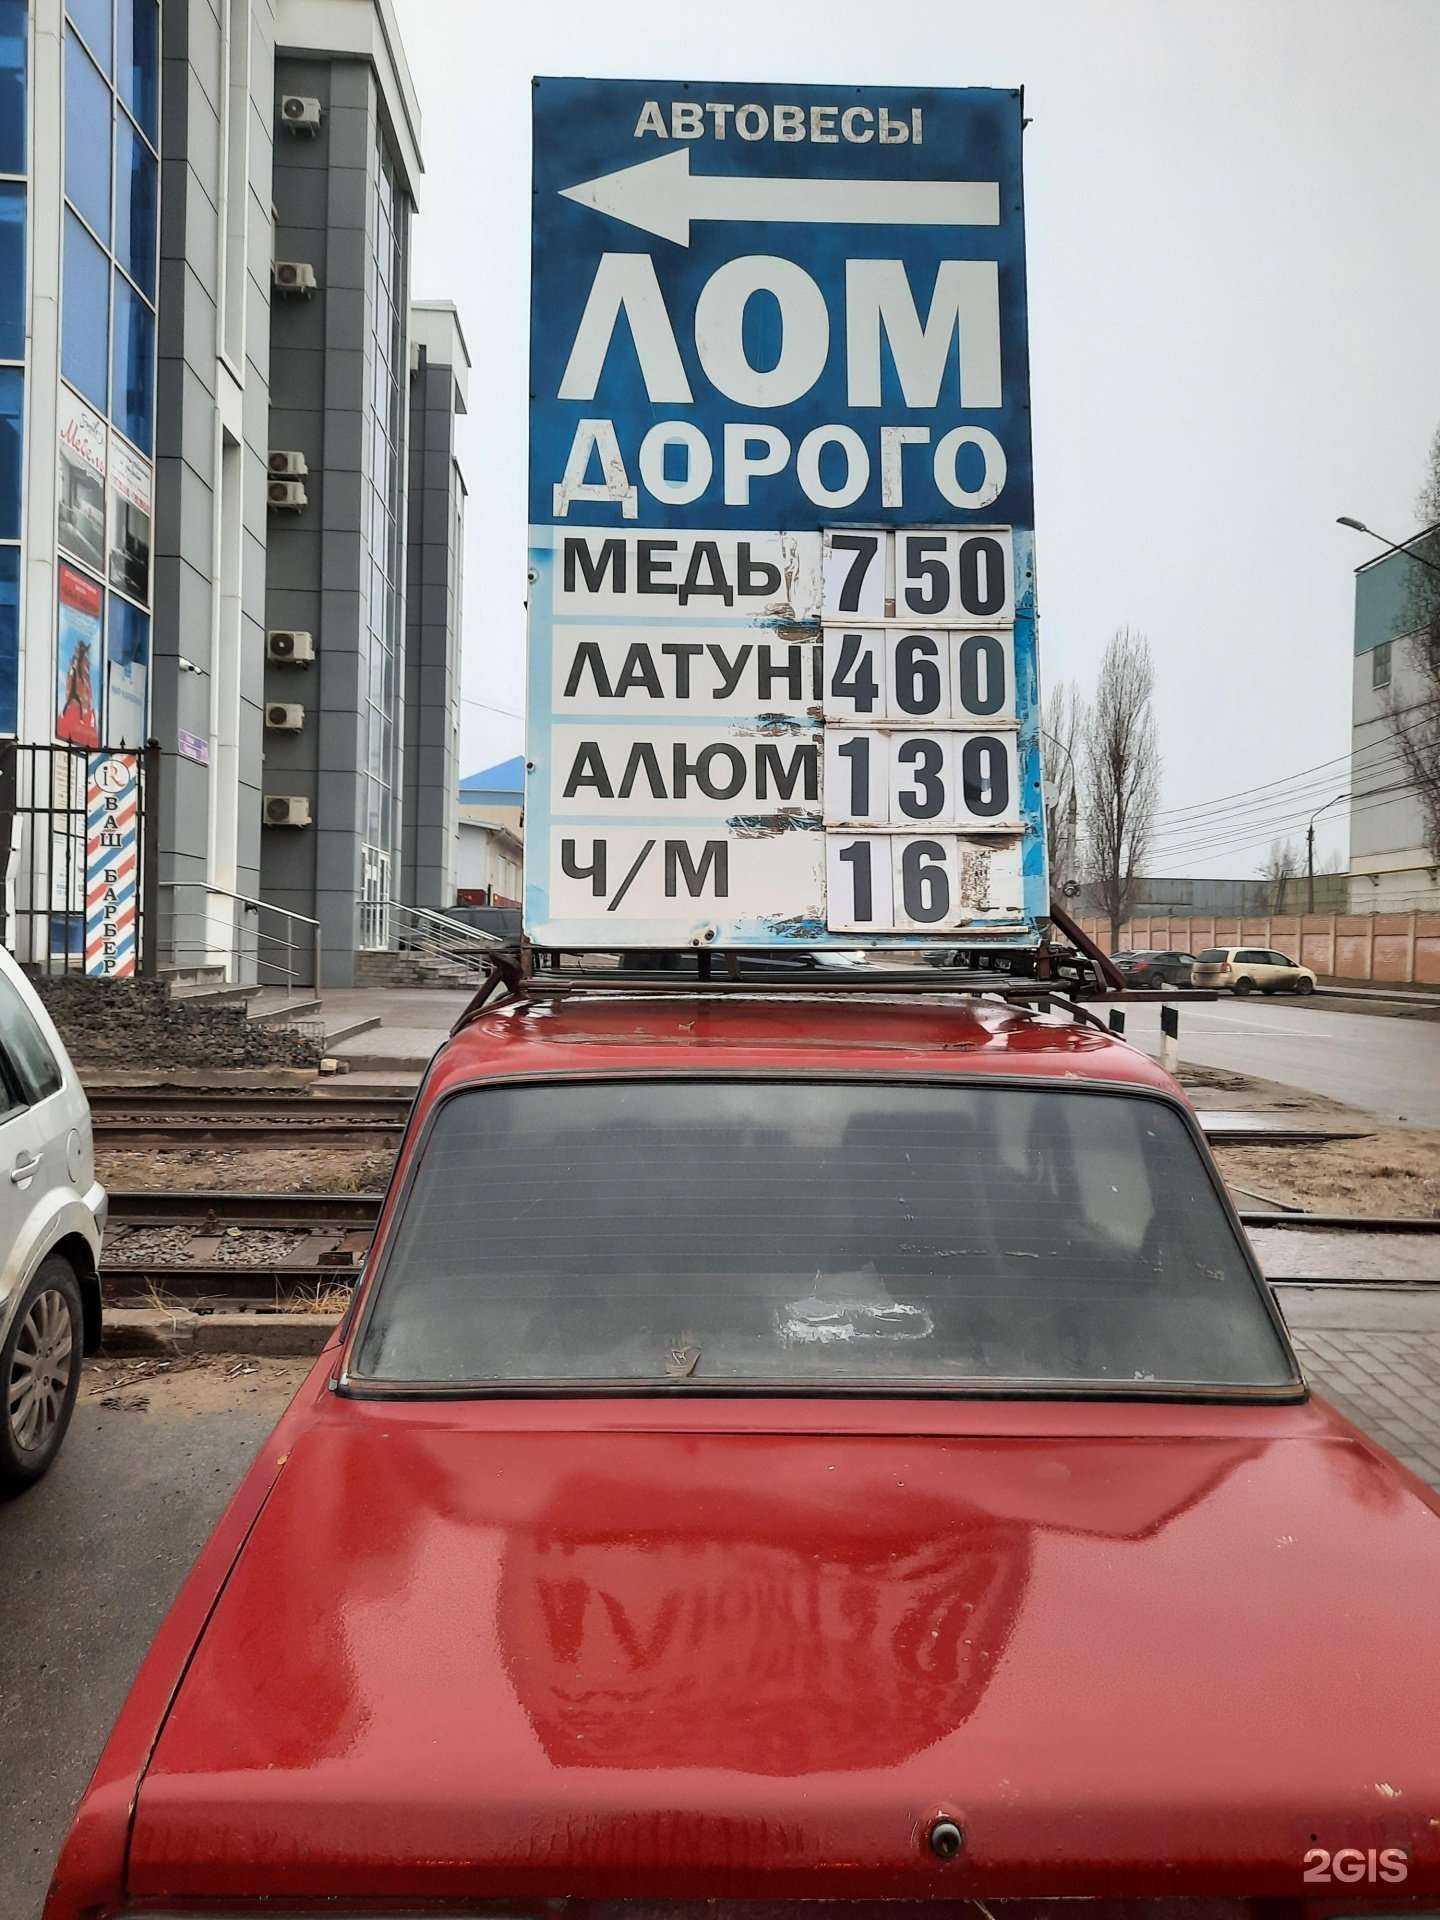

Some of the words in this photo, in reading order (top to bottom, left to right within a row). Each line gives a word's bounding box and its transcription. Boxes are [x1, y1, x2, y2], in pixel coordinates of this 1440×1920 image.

[633, 101, 923, 145] АВТОВЕСЫ
[557, 252, 1002, 408] ЛОМ
[552, 419, 1007, 519] ДОРОГО
[563, 538, 781, 607] МЕДЬ
[831, 534, 1005, 616] 750
[831, 634, 1005, 715] 460
[562, 741, 818, 800] АЛЮМ
[838, 736, 1008, 820] 130
[101, 797, 121, 847] ВАШ
[103, 869, 117, 974] БАРБЕР
[561, 839, 728, 912] Ч/М
[840, 840, 950, 924] 16
